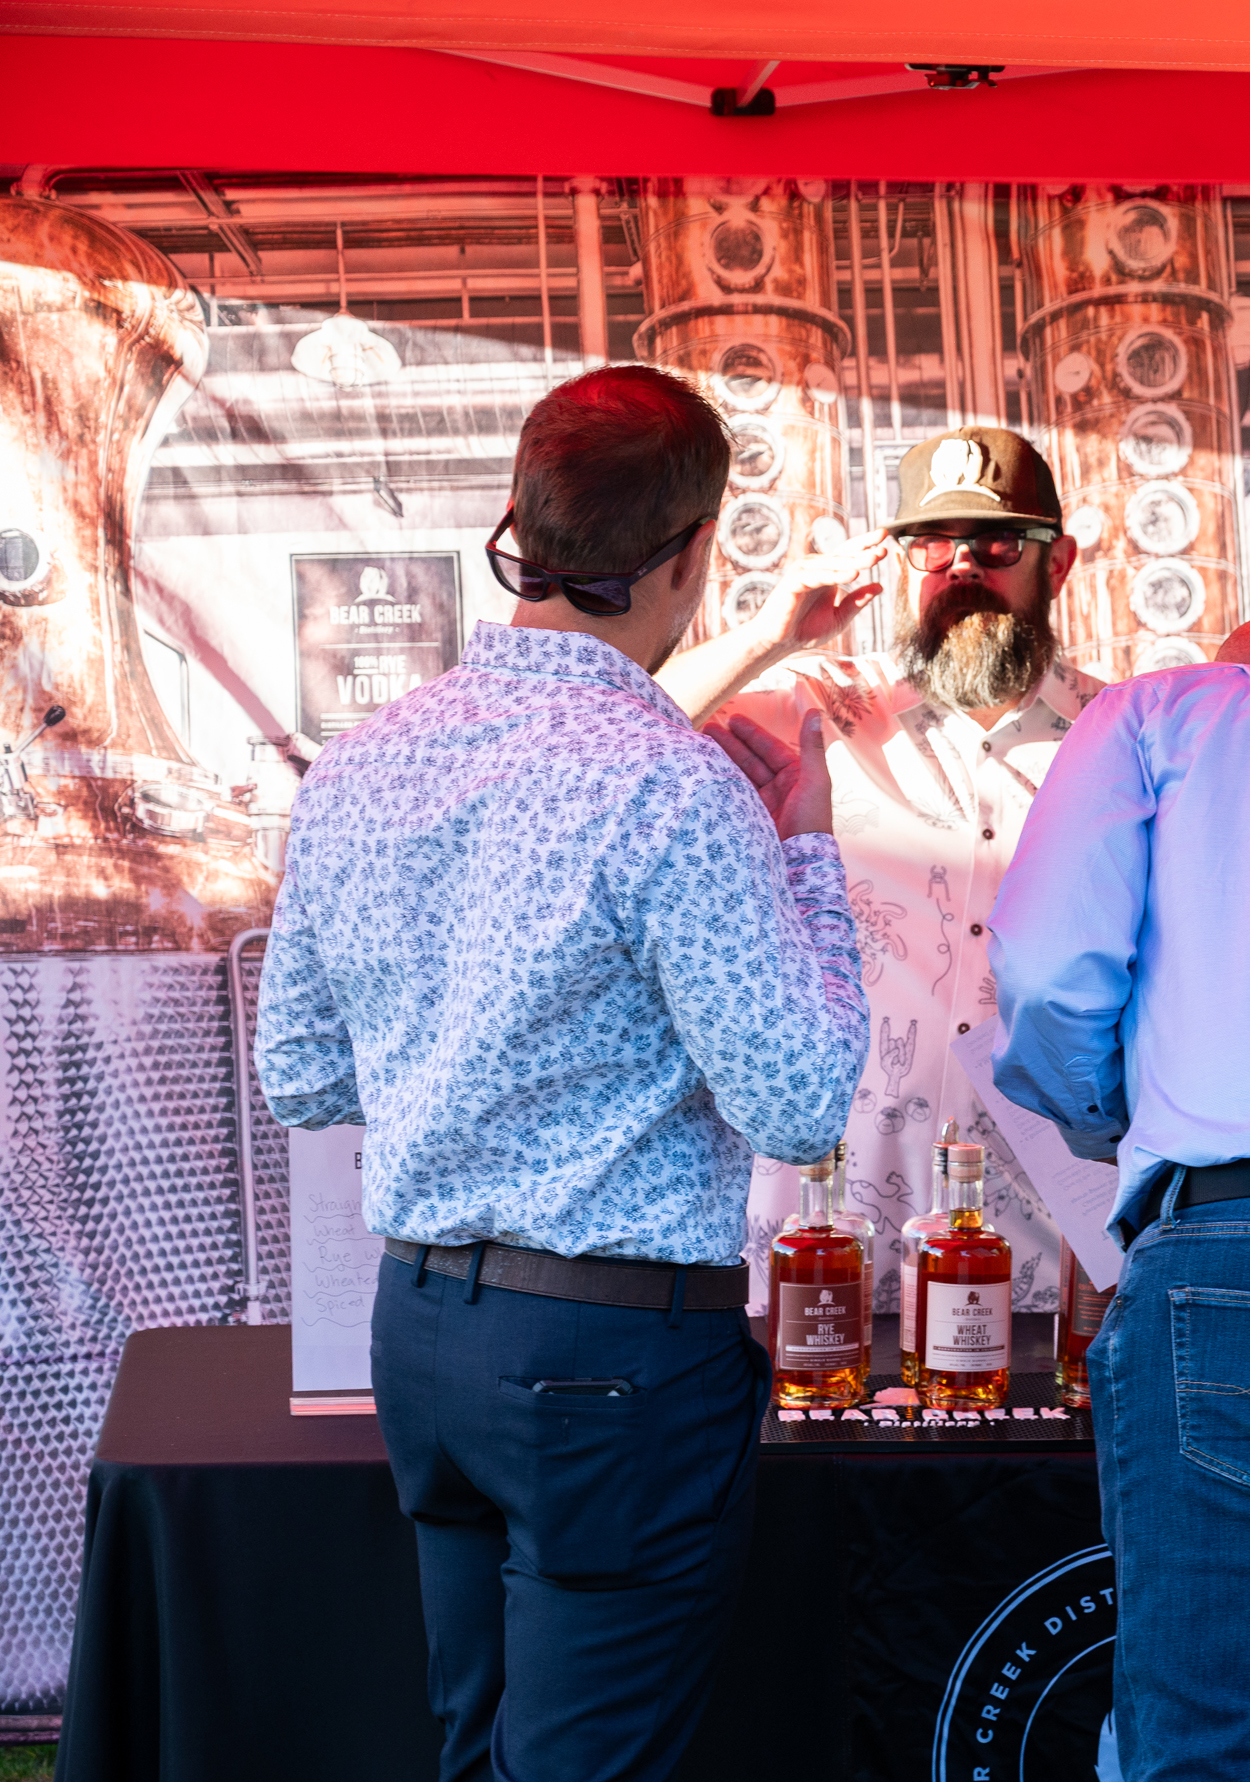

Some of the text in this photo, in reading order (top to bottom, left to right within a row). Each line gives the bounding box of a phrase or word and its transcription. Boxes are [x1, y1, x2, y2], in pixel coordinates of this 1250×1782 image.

[329, 604, 422, 625] BEAR CREEK
[378, 654, 406, 675] RYE
[308, 1192, 362, 1219] Straigh
[318, 1245, 352, 1272] Rye
[315, 1297, 366, 1316] Spiced
[804, 1306, 847, 1316] BEAR CREEK
[952, 1307, 993, 1316] BEAR CREEK
[817, 1323, 835, 1335] RYE
[957, 1324, 987, 1335] WHEAT
[805, 1333, 845, 1346] WHISKEY
[952, 1335, 992, 1346] WHISKEY
[777, 1407, 1071, 1422] BEAR CREEK
[975, 1641, 1037, 1744] CREEK
[1044, 1587, 1114, 1636] DIST
